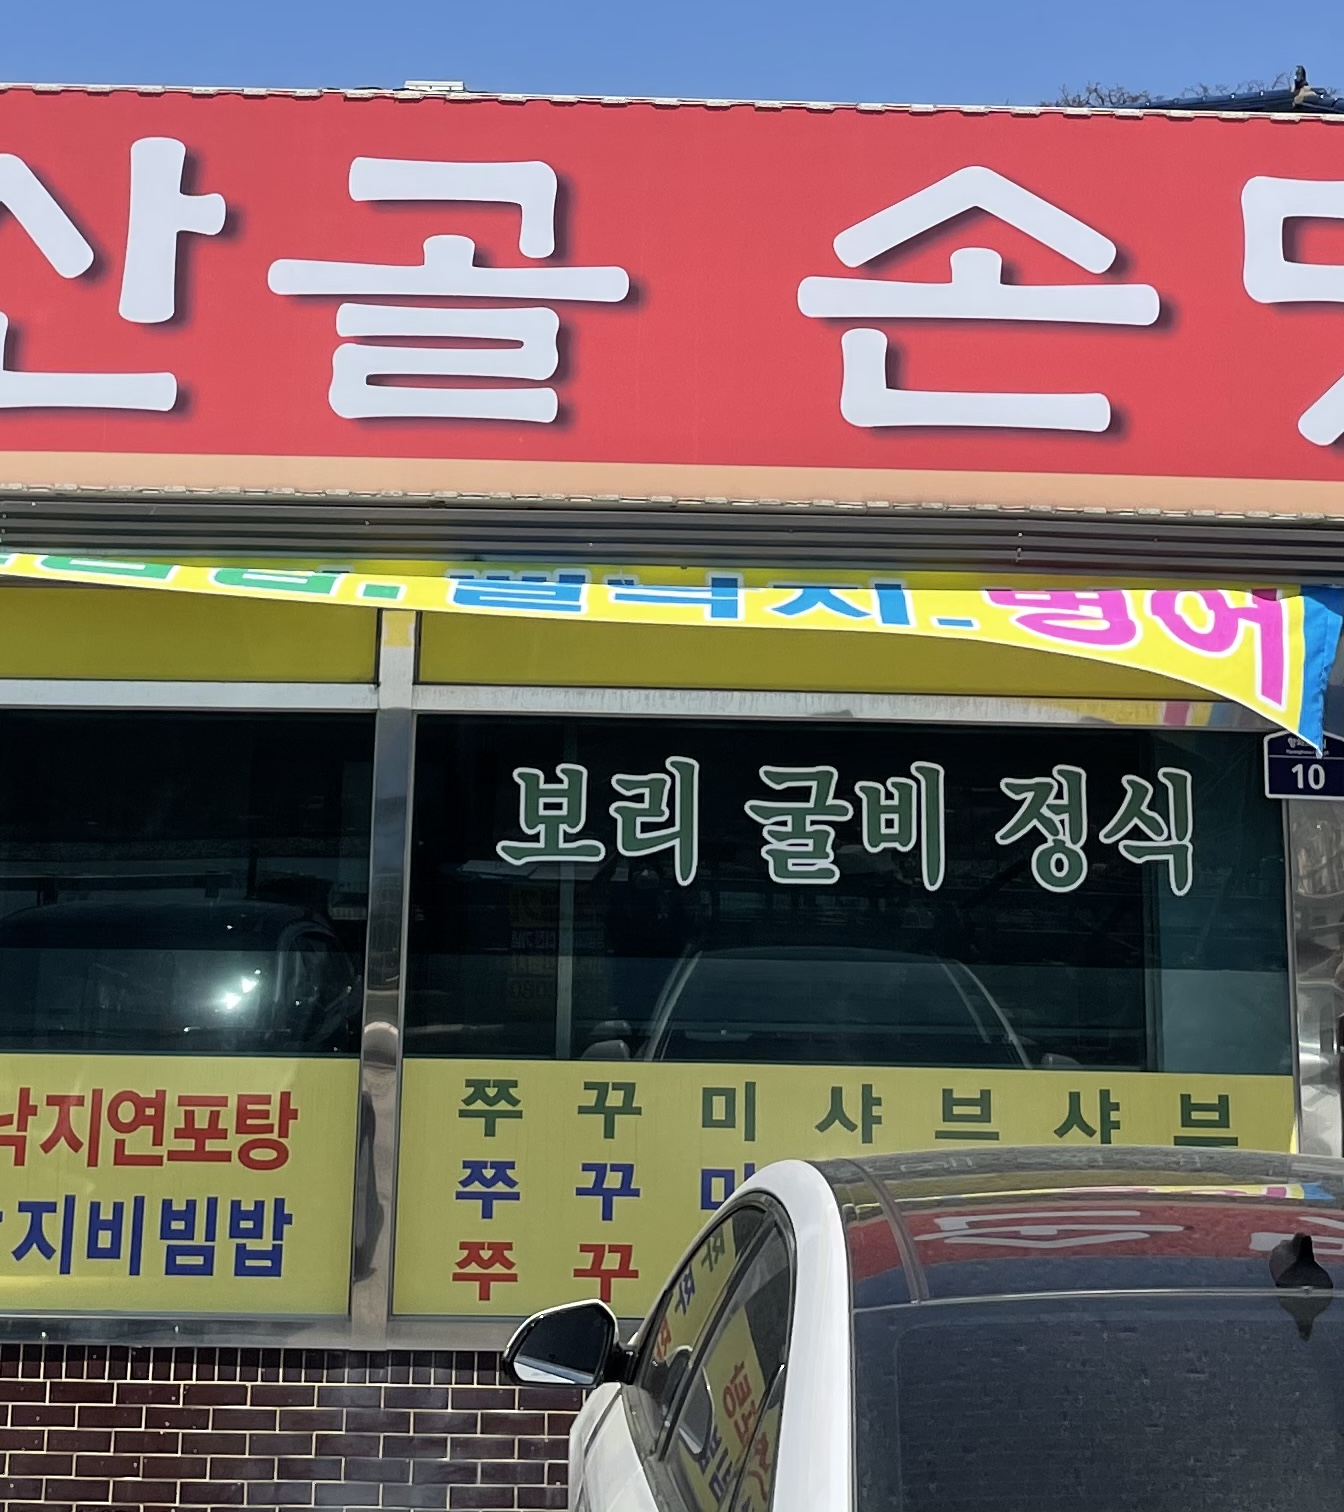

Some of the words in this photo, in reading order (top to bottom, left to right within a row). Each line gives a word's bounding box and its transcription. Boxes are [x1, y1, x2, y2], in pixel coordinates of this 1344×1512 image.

[1291, 763, 1326, 790] 10
[496, 757, 702, 886] 보리
[744, 760, 946, 891] 굴비
[996, 764, 1194, 897] 정식
